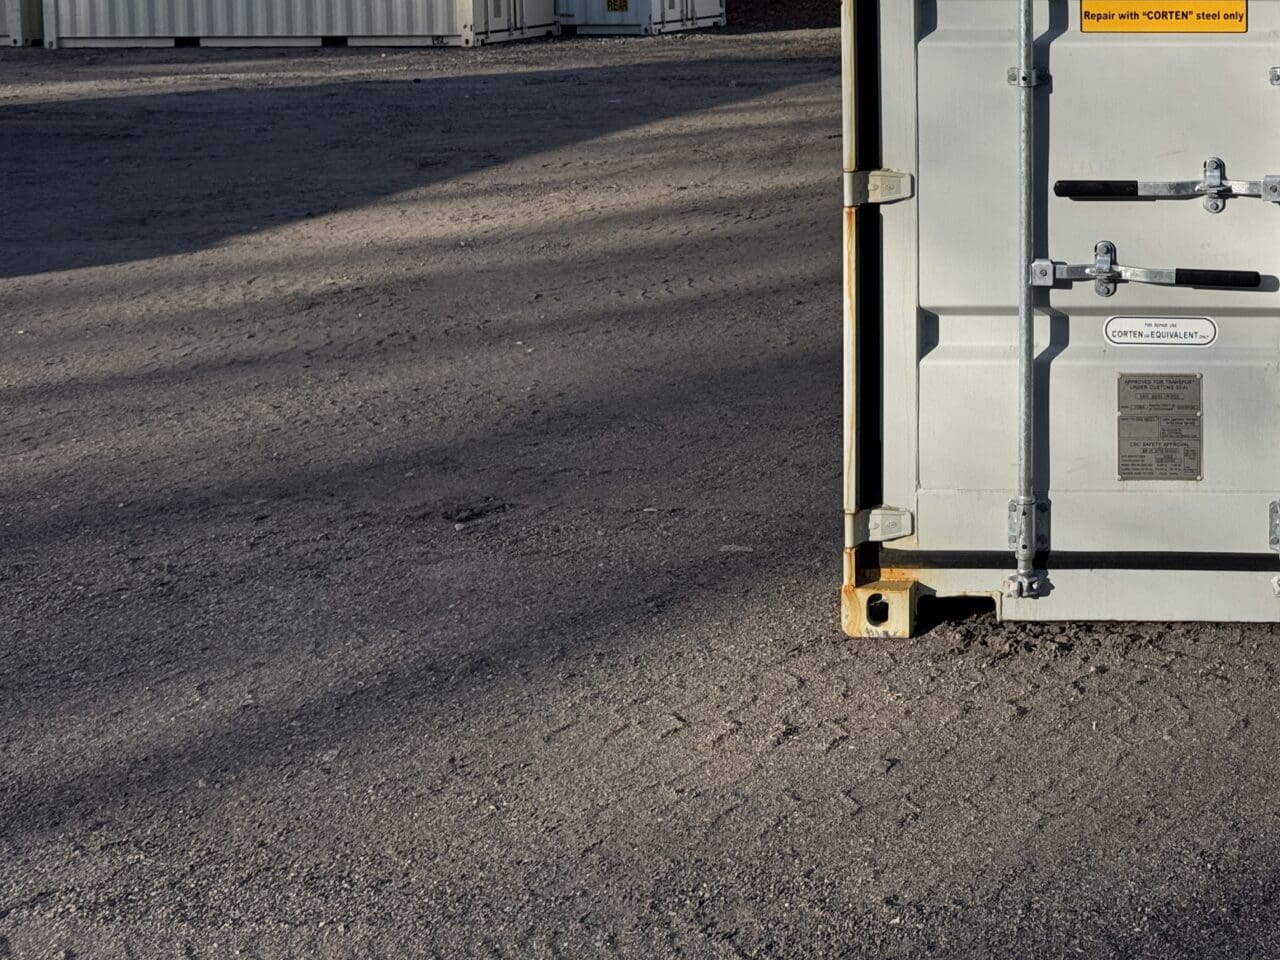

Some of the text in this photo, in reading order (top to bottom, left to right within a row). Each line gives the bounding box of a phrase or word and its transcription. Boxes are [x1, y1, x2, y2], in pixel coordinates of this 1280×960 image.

[1084, 11, 1115, 22] Repair
[1118, 11, 1139, 20] with
[1196, 11, 1220, 20] steel
[1223, 11, 1244, 22] only
[1111, 330, 1144, 338] CORTEN
[1150, 331, 1198, 339] EQUIVALENT
